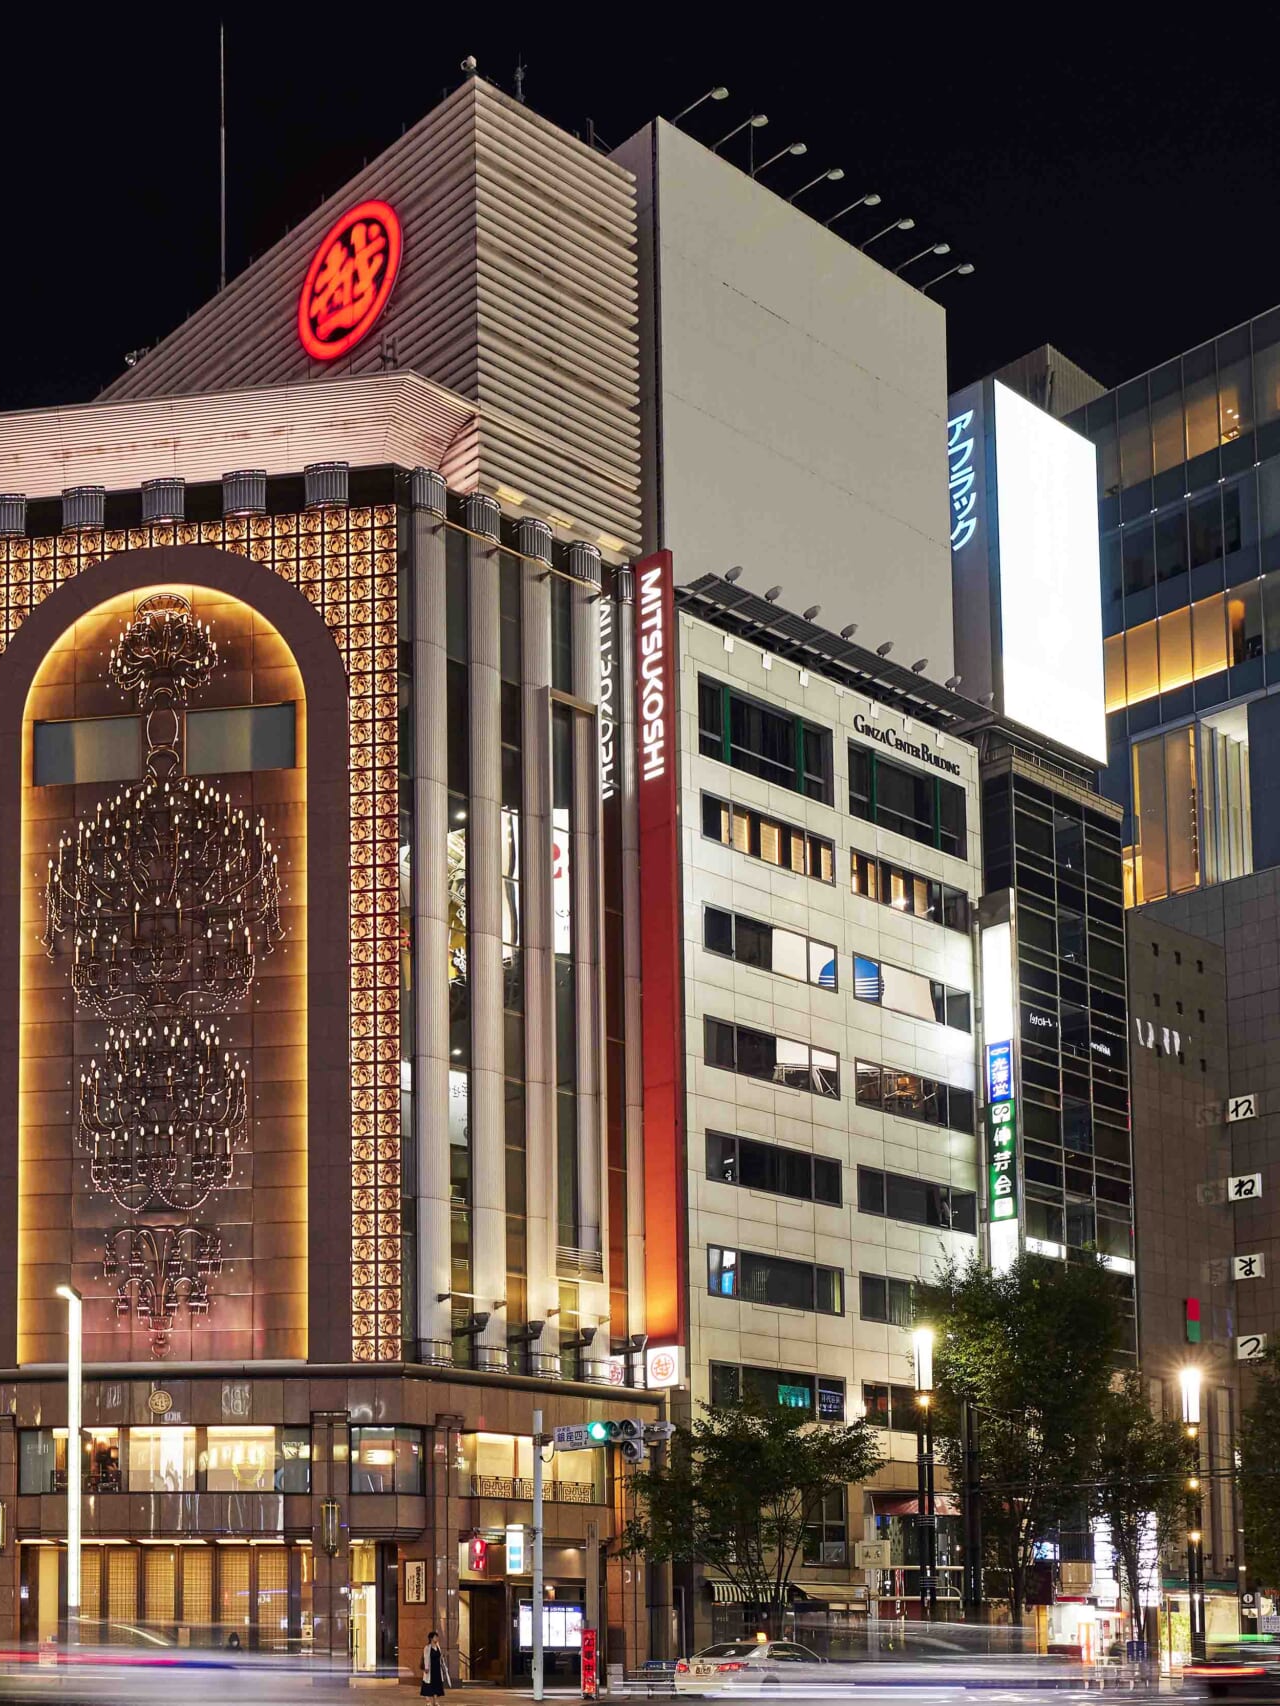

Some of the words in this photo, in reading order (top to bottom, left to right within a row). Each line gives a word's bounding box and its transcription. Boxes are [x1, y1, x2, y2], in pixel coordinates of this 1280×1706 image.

[947, 409, 977, 552] アフラック
[641, 567, 665, 781] MITSUKOSHI
